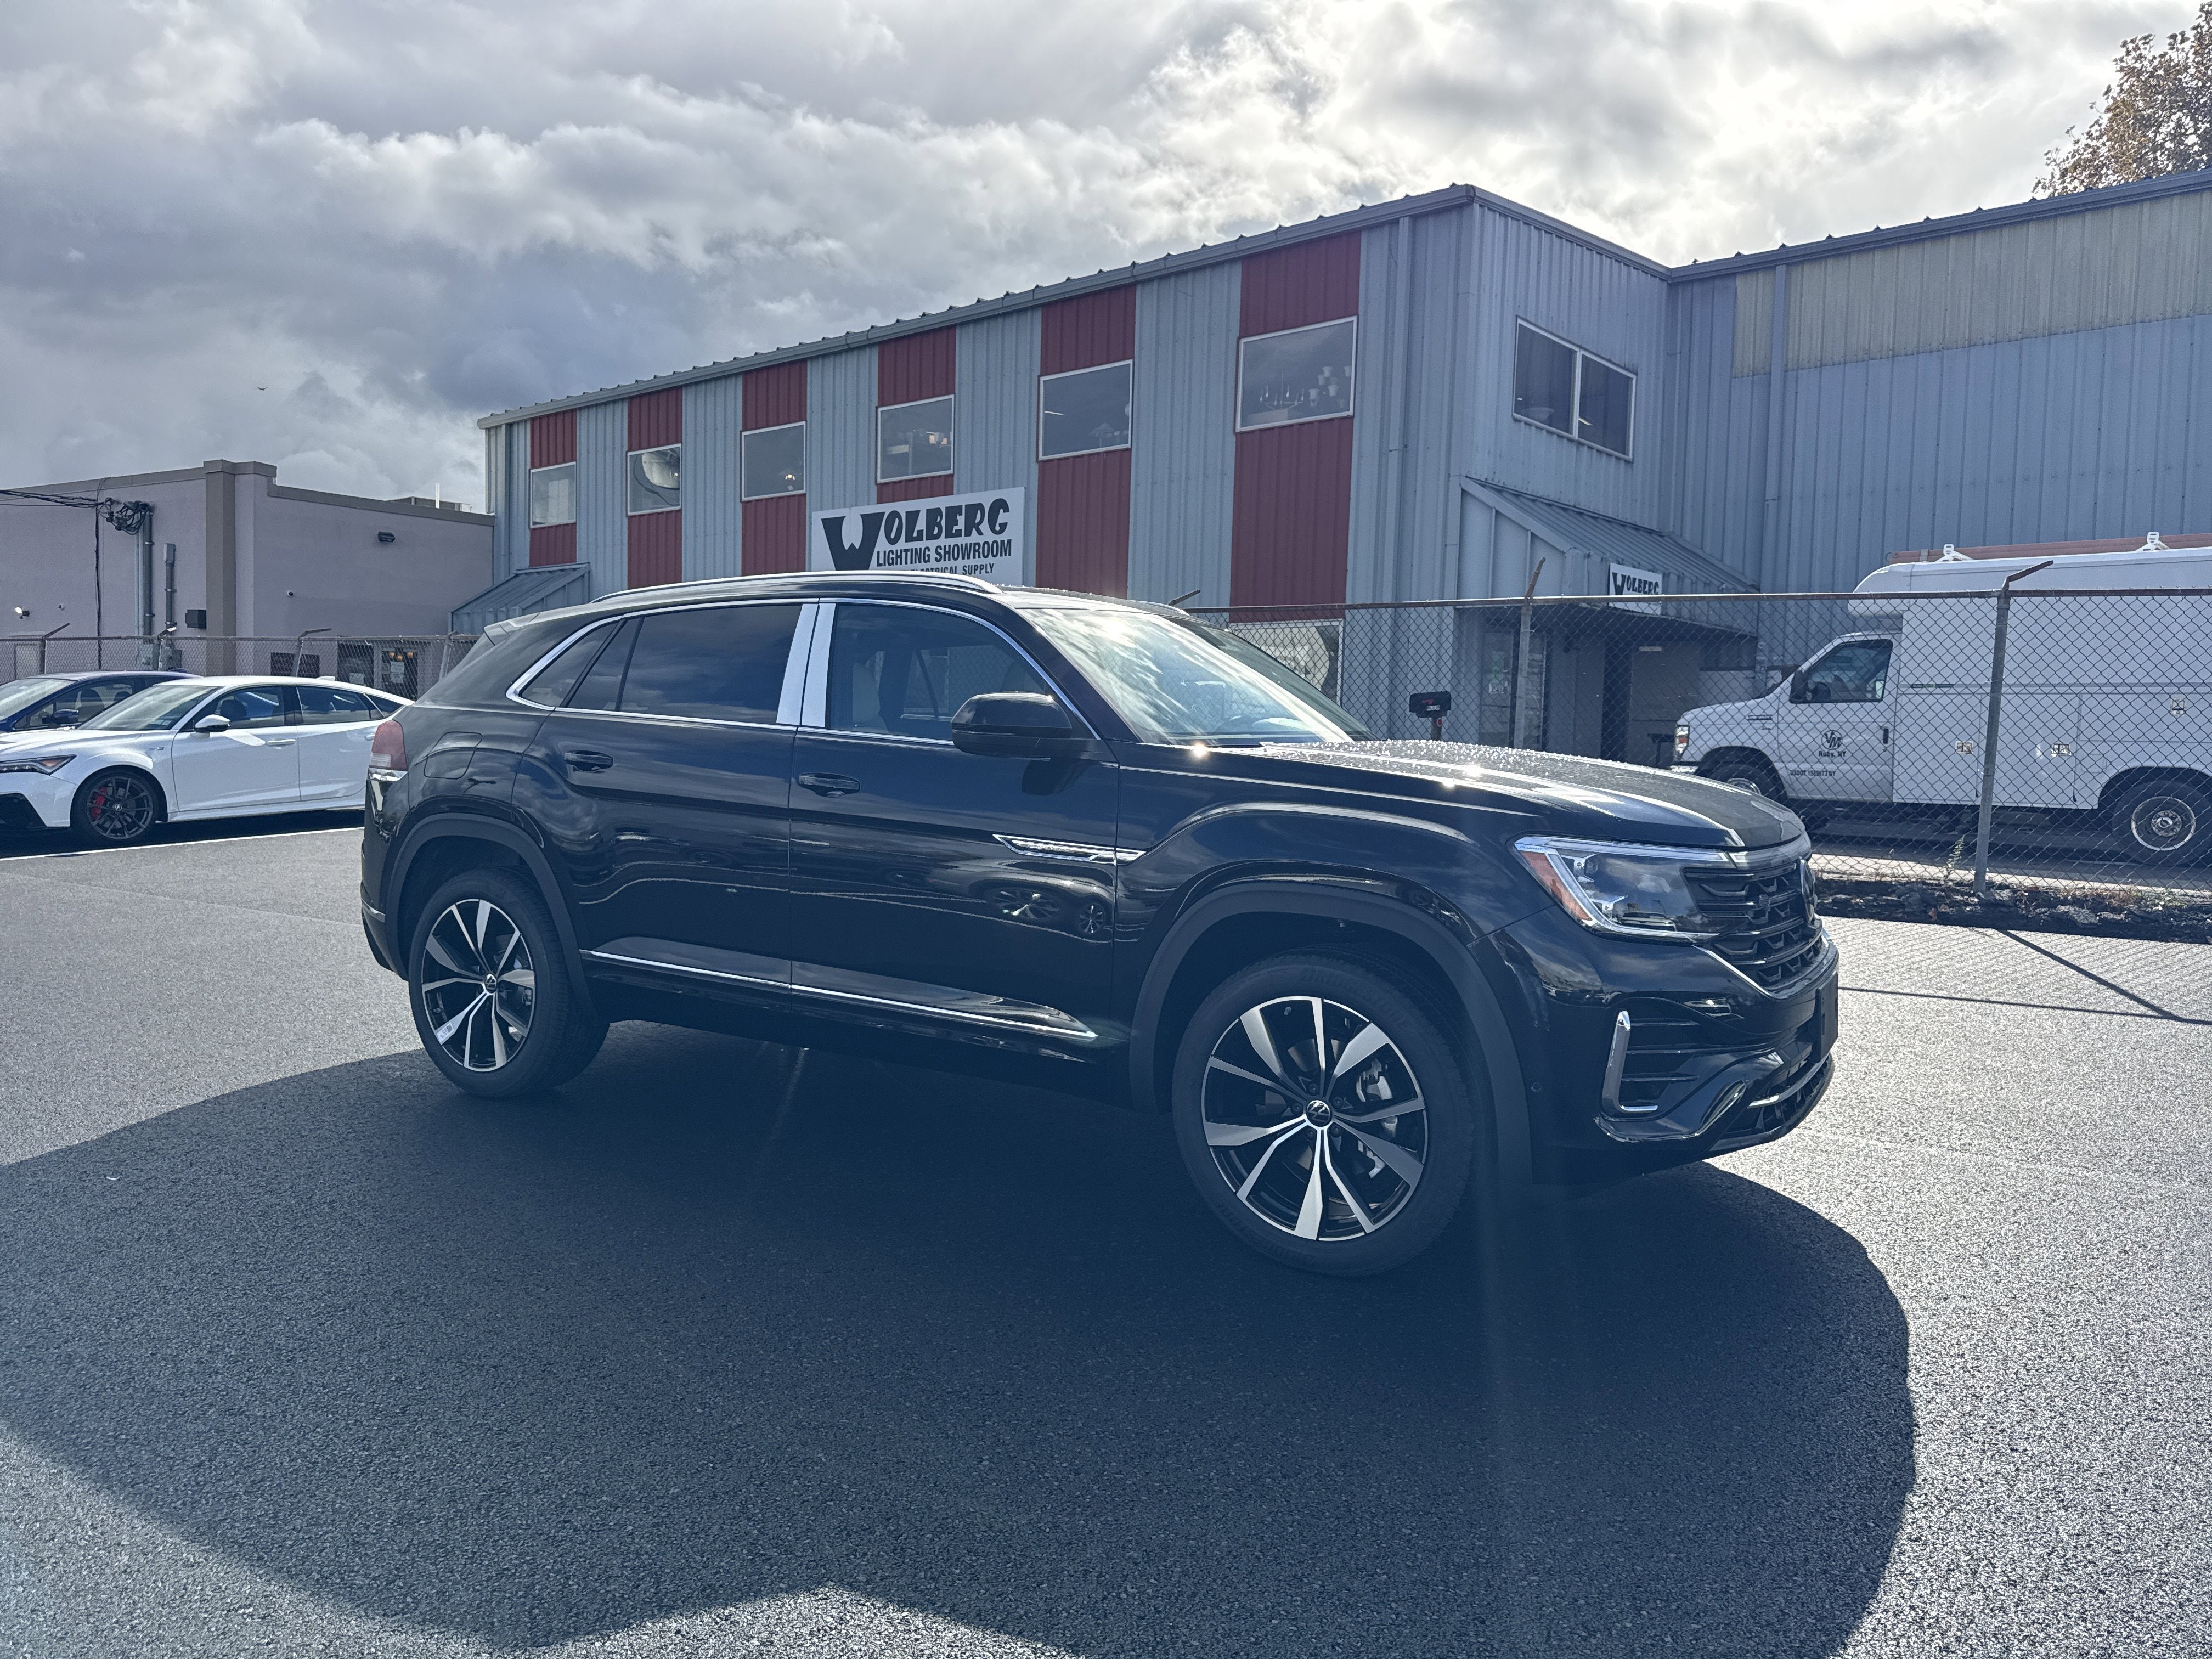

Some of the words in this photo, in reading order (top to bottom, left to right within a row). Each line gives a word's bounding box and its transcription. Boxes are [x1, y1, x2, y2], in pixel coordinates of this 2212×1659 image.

[821, 498, 1010, 571] WOLBERG
[877, 546, 930, 567] LIGHTING
[935, 539, 1012, 562] SHOWROOM
[962, 563, 995, 575] SUPPLY
[1612, 572, 1660, 595] WOLBERG
